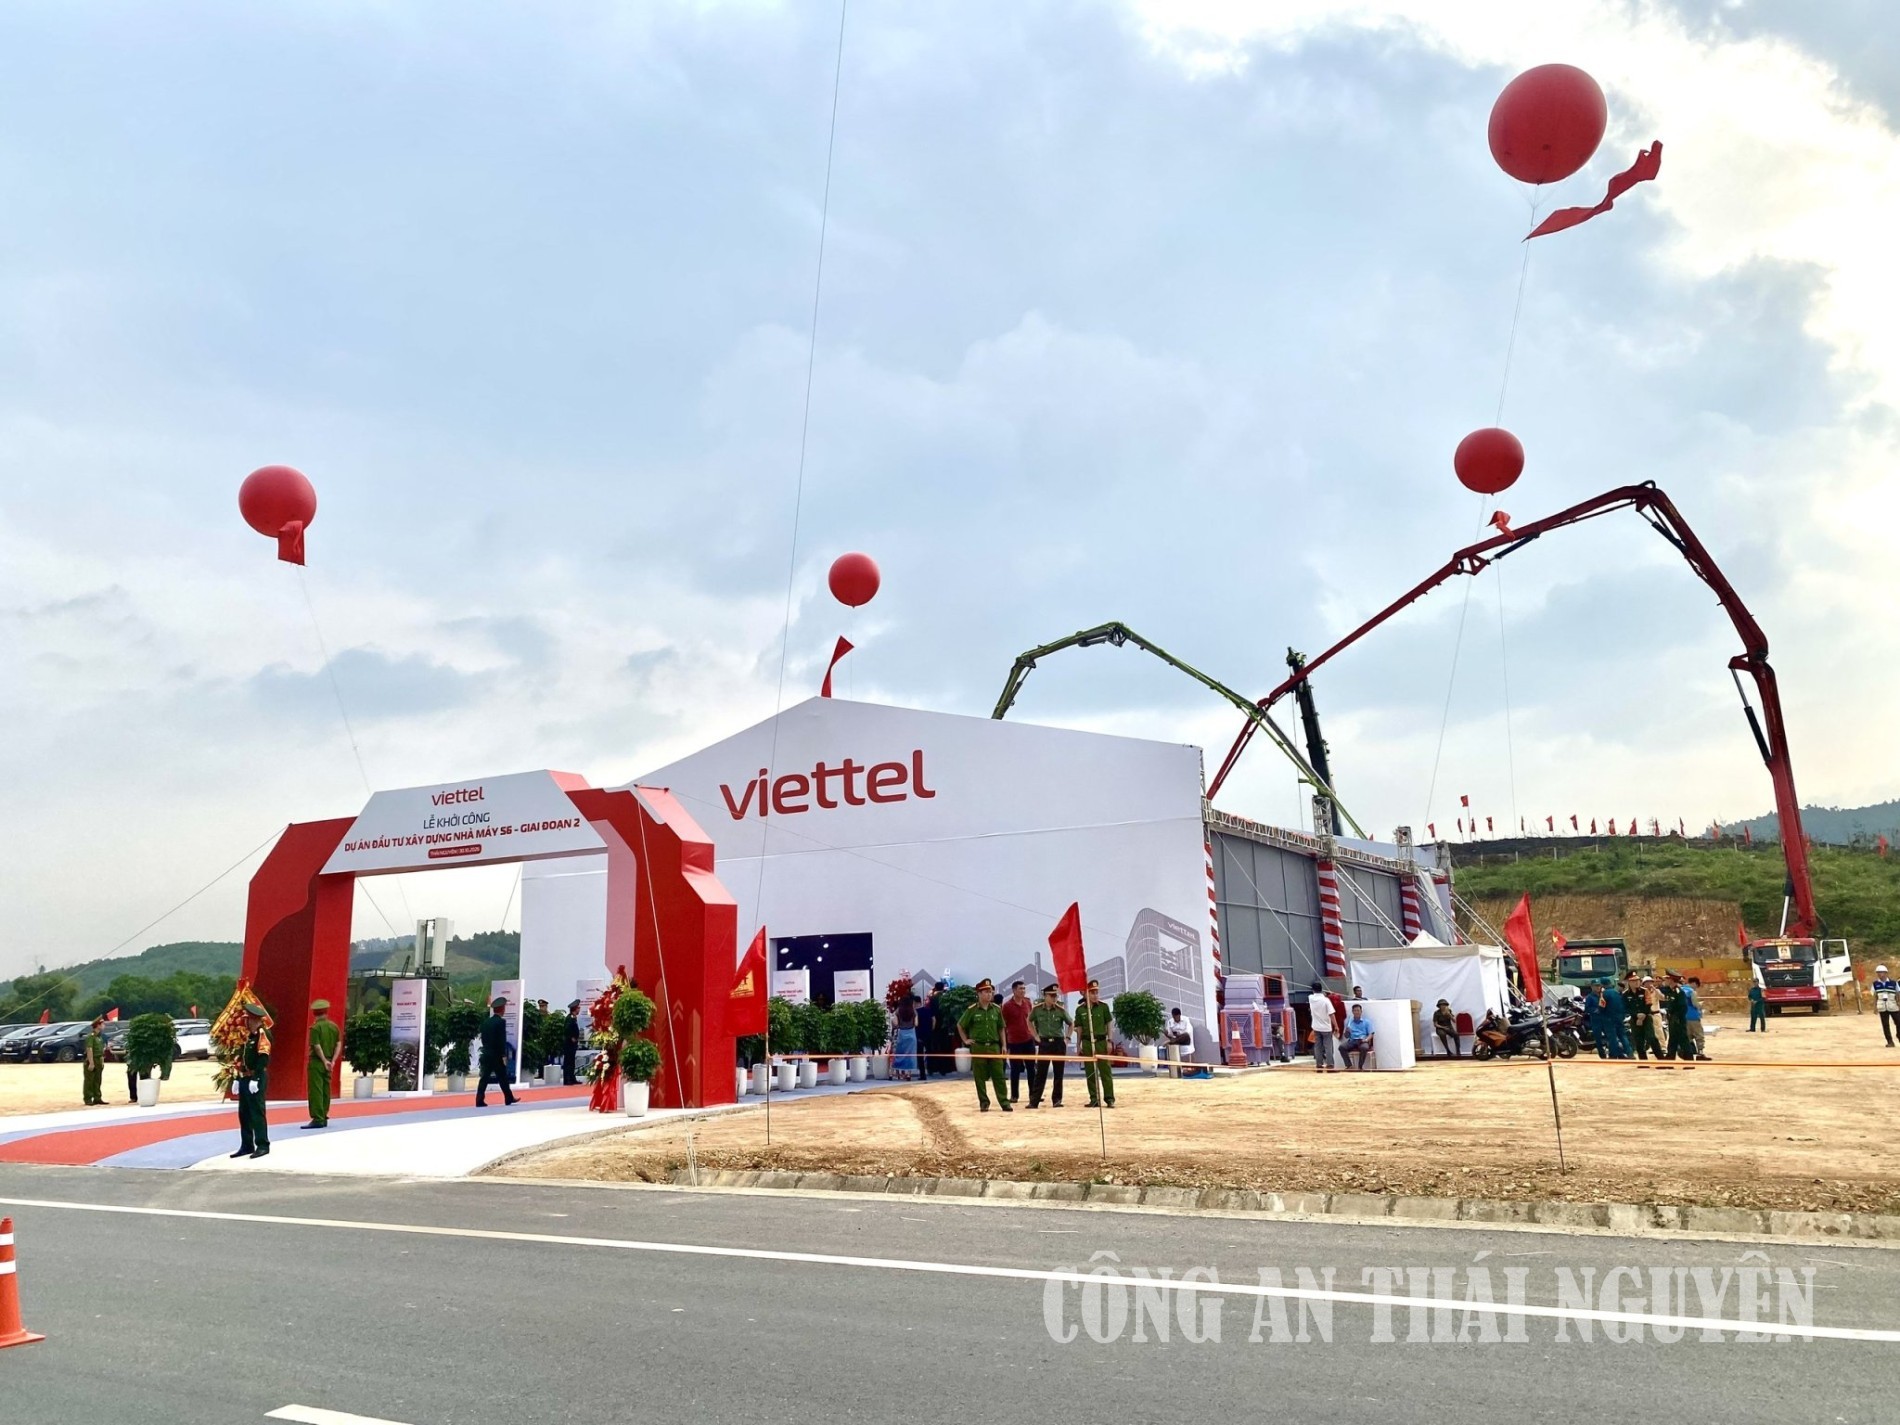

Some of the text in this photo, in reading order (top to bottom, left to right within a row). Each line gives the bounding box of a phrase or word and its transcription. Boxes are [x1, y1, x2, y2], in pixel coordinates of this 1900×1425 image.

[431, 786, 485, 806] viettel
[719, 749, 936, 821] viettel
[423, 811, 490, 829] LỄ KHỞI CÔNG
[344, 839, 357, 853] DỰ
[358, 838, 371, 851] ÁN
[372, 834, 390, 849] ĐẦU
[391, 836, 405, 847] TƯ
[405, 834, 425, 846] XÂY
[426, 832, 452, 846] DỰNG
[453, 827, 474, 841] NHÀ
[476, 825, 499, 839] MÁY
[500, 825, 513, 836] S6
[520, 822, 540, 833] GIAI
[541, 818, 572, 831] ĐOẠN
[573, 818, 580, 827] 2
